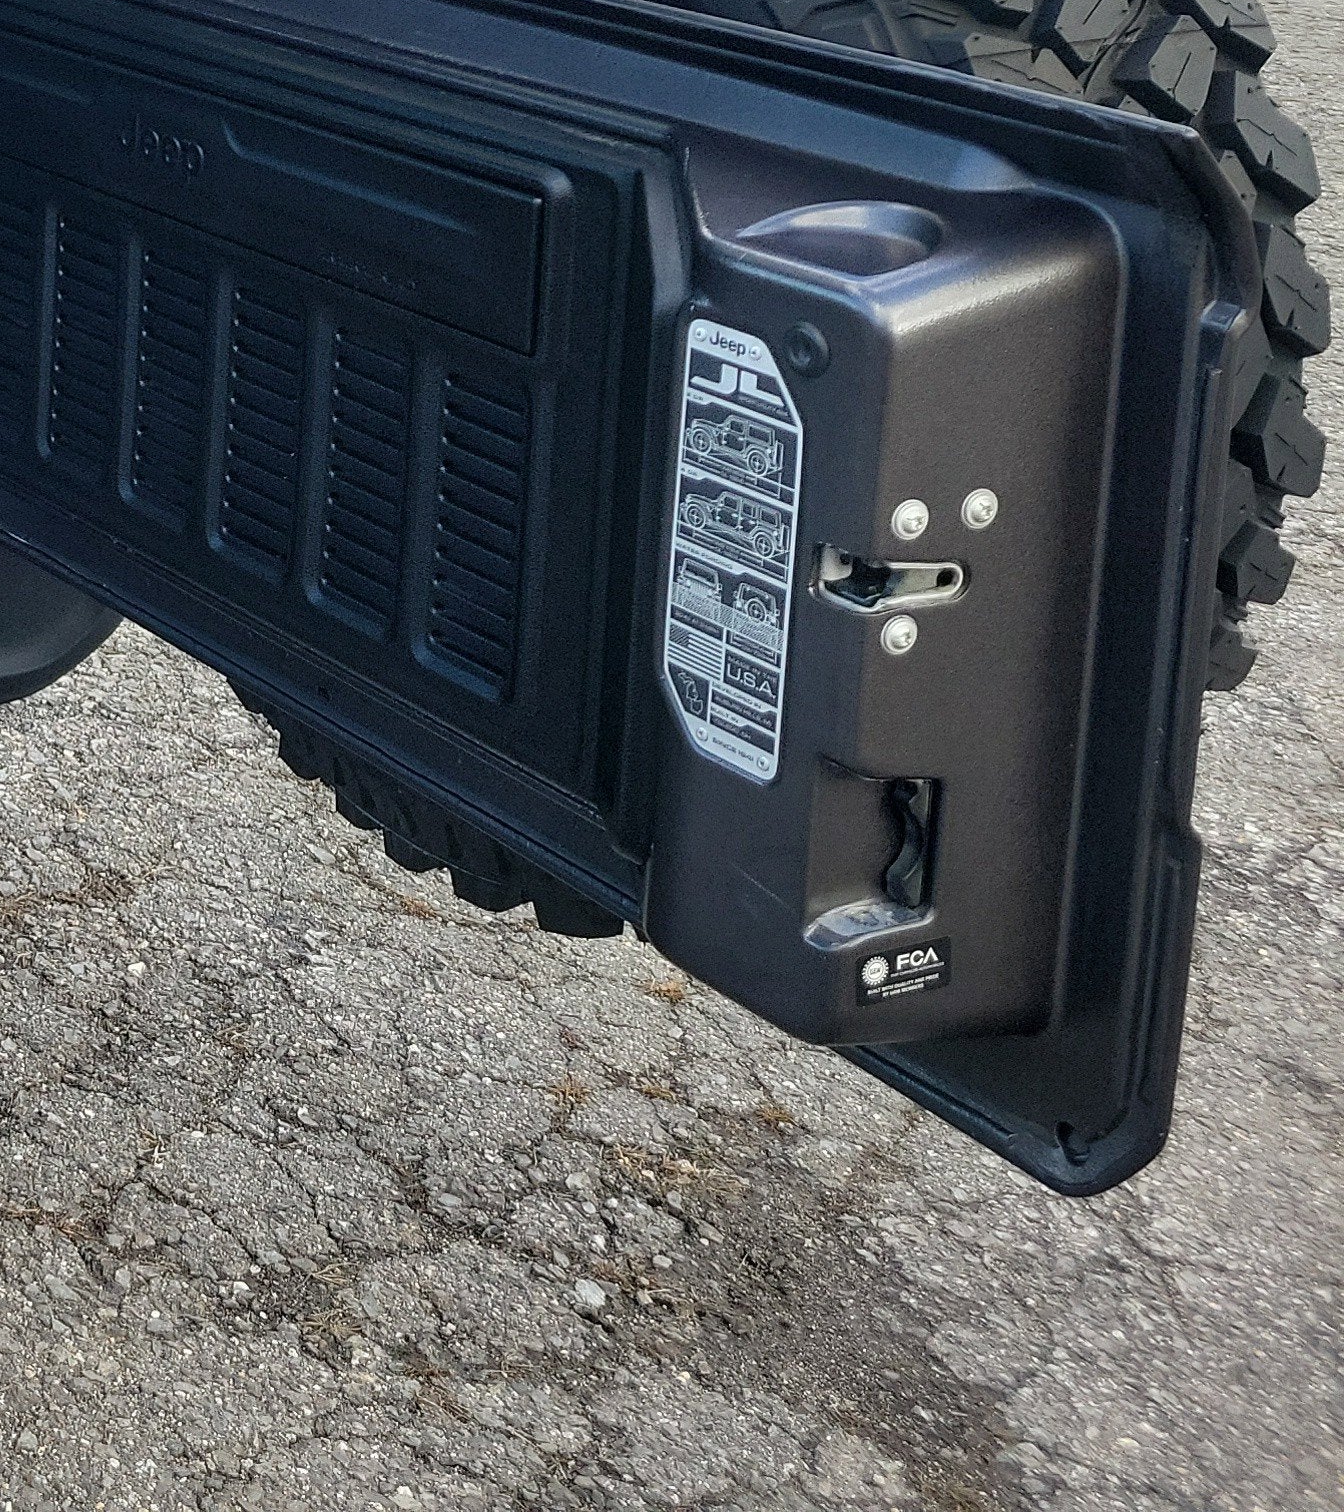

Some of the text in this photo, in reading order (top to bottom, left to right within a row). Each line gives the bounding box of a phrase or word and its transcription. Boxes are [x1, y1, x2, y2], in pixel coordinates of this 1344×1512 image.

[121, 113, 205, 185] Jeep
[709, 331, 747, 356] Jeep
[690, 363, 785, 407] JL
[727, 663, 777, 699] U.S.A.
[896, 947, 940, 970] FCA
